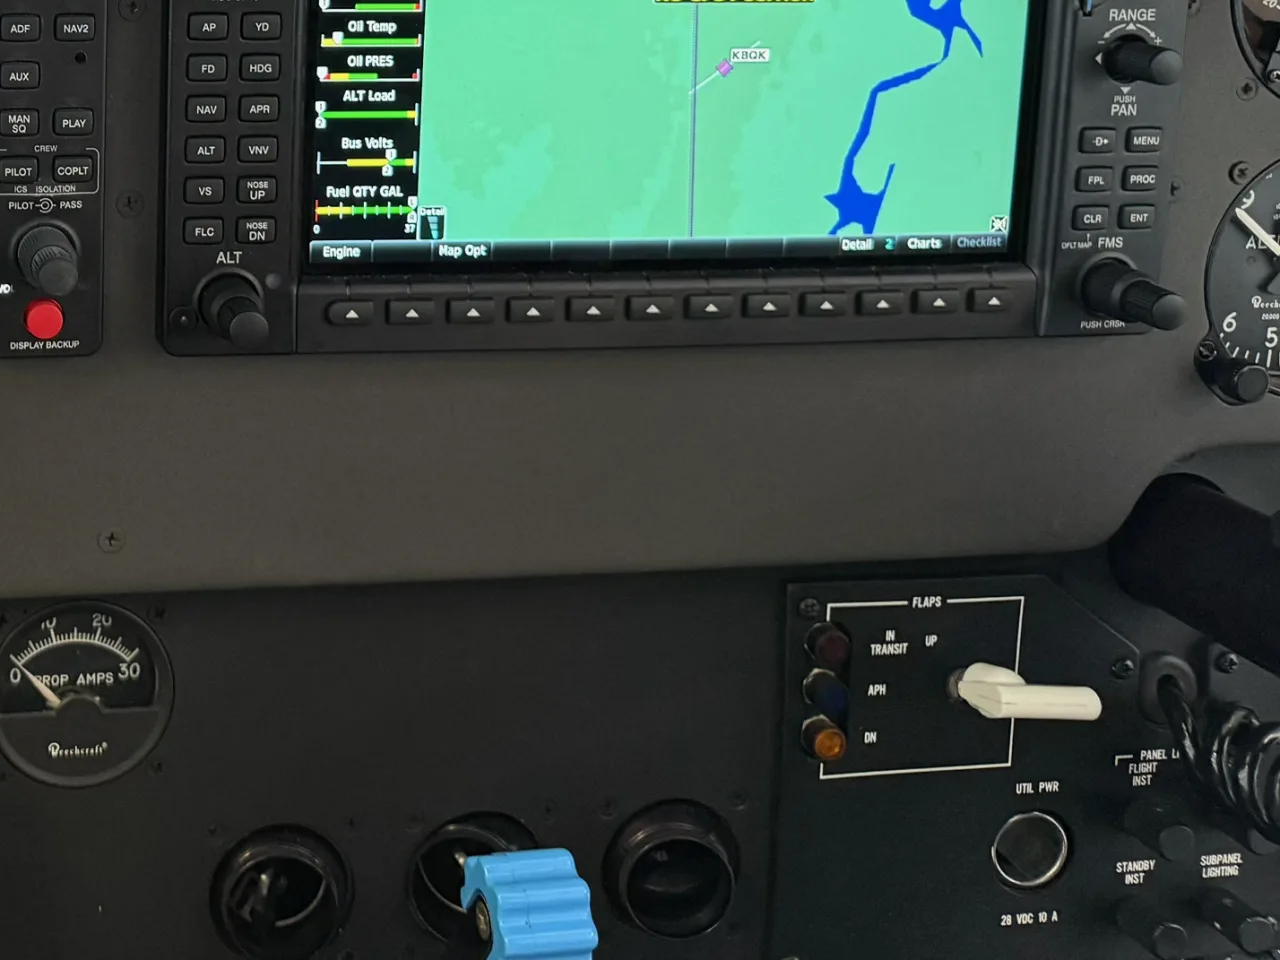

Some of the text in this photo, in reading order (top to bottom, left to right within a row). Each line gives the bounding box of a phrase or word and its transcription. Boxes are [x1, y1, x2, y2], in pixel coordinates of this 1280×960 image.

[1109, 8, 1156, 22] RANGE
[9, 72, 29, 81] AUX
[62, 119, 86, 128] PLAY
[248, 145, 269, 155] VNV
[4, 167, 32, 177] PILOT
[57, 166, 89, 176] COPLT
[326, 186, 403, 199] Fuel QTY GAL
[195, 227, 215, 237] FLC
[907, 237, 942, 249] Charts
[1098, 237, 1123, 249] FMS
[216, 251, 242, 264] ALT
[323, 246, 360, 260] Engine
[10, 340, 80, 350] DISPLAY BACKUP
[912, 596, 942, 609] FLAPS
[870, 642, 908, 656] TRANSIT
[76, 671, 114, 686] AMPS
[1128, 762, 1158, 775] FLIGHT
[1016, 781, 1059, 795] UTIL PWR
[1200, 853, 1243, 866] SUBPANEL
[1116, 860, 1156, 873] STANDBY
[1202, 865, 1239, 878] LIGHTING
